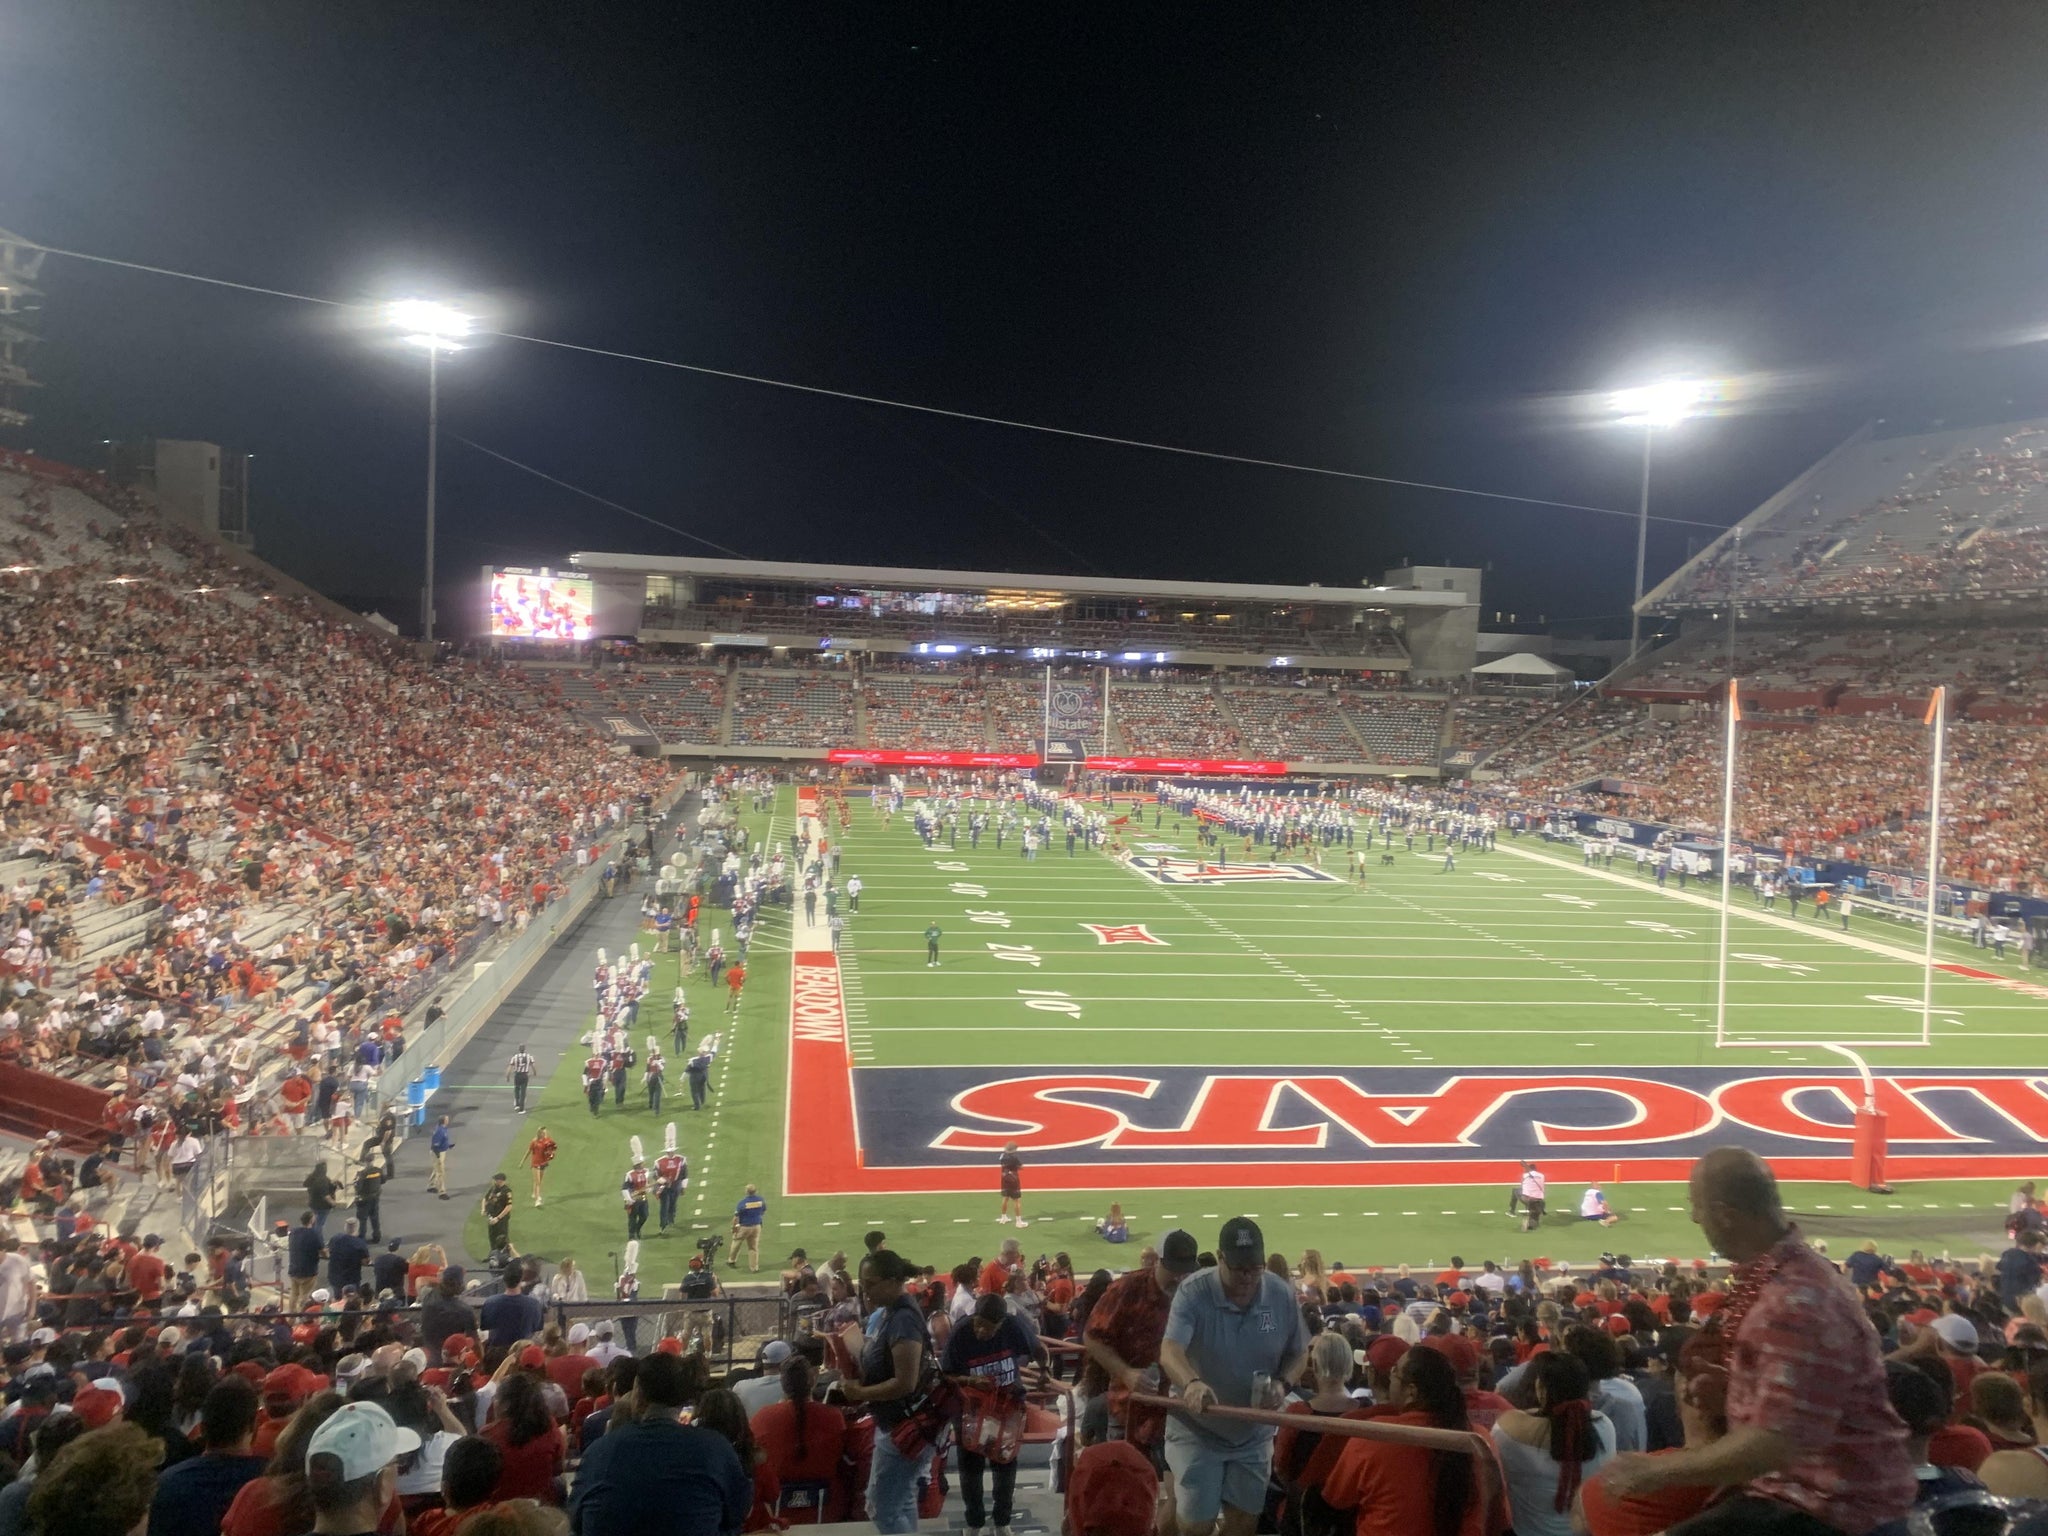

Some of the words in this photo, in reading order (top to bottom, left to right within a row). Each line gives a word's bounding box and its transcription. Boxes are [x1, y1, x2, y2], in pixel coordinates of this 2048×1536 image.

[948, 882, 988, 896] 40
[965, 909, 1012, 926] 30
[986, 942, 1042, 965] 20
[1017, 989, 1082, 1014] 10
